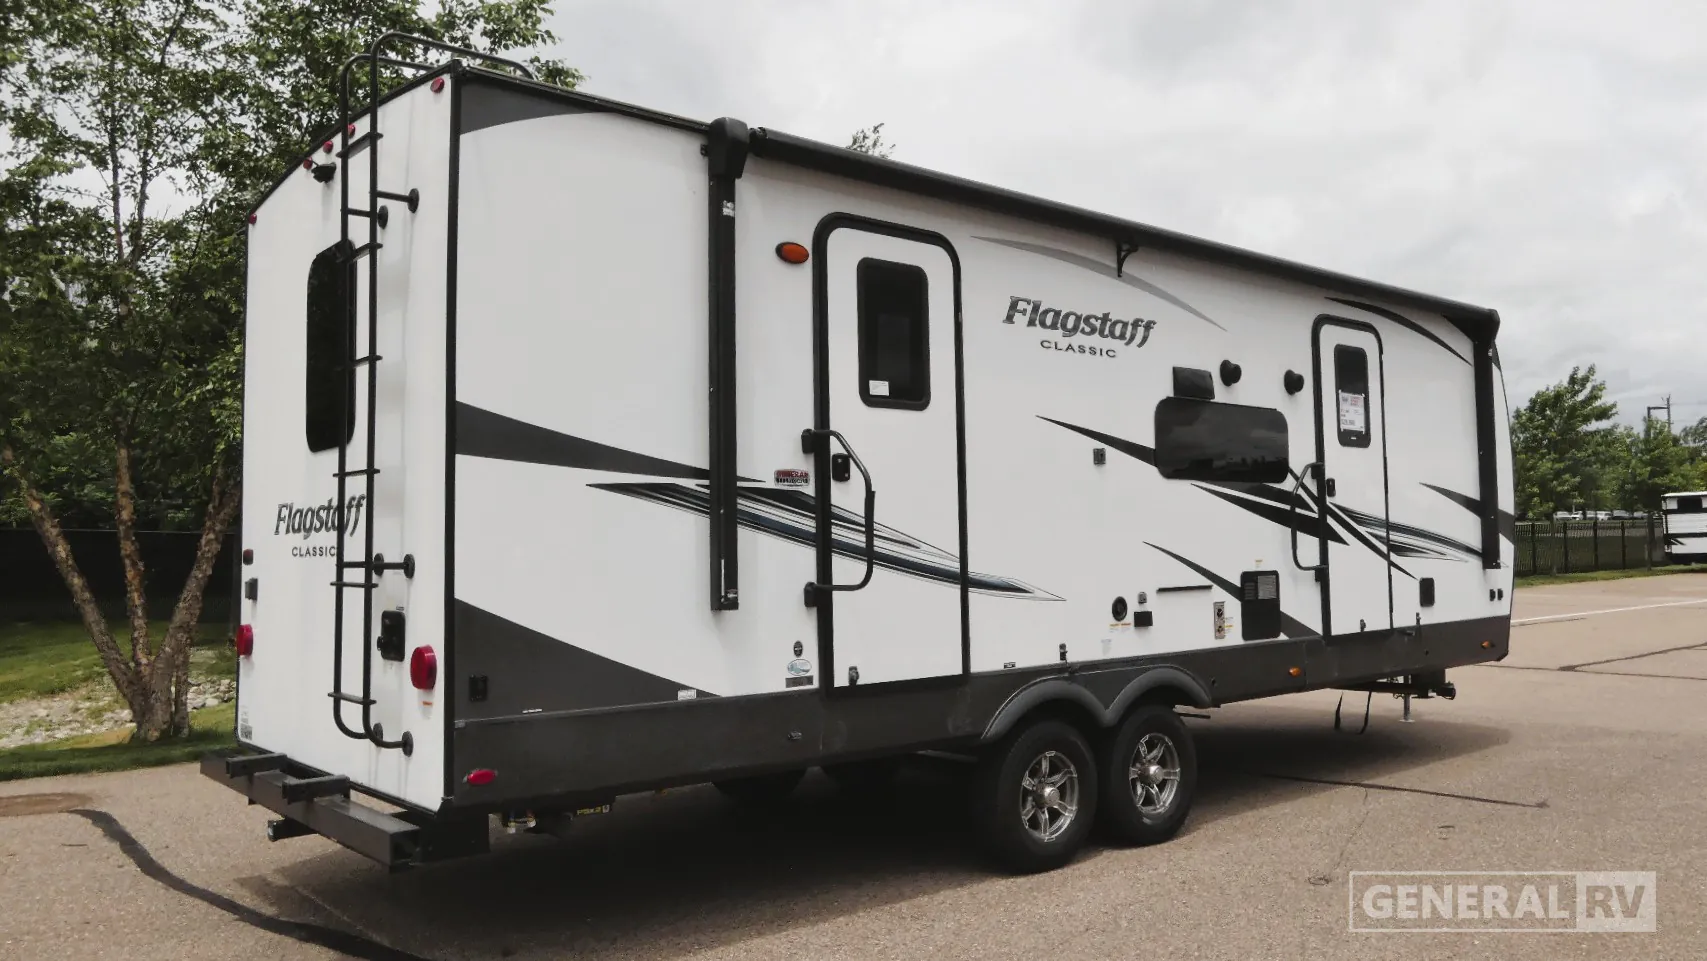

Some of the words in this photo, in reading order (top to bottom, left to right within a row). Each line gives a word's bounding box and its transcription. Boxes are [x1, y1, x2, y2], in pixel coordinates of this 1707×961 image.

[1003, 296, 1157, 348] Flagstaff
[1040, 340, 1117, 358] CLASSIC
[292, 547, 336, 557] CLASSIC
